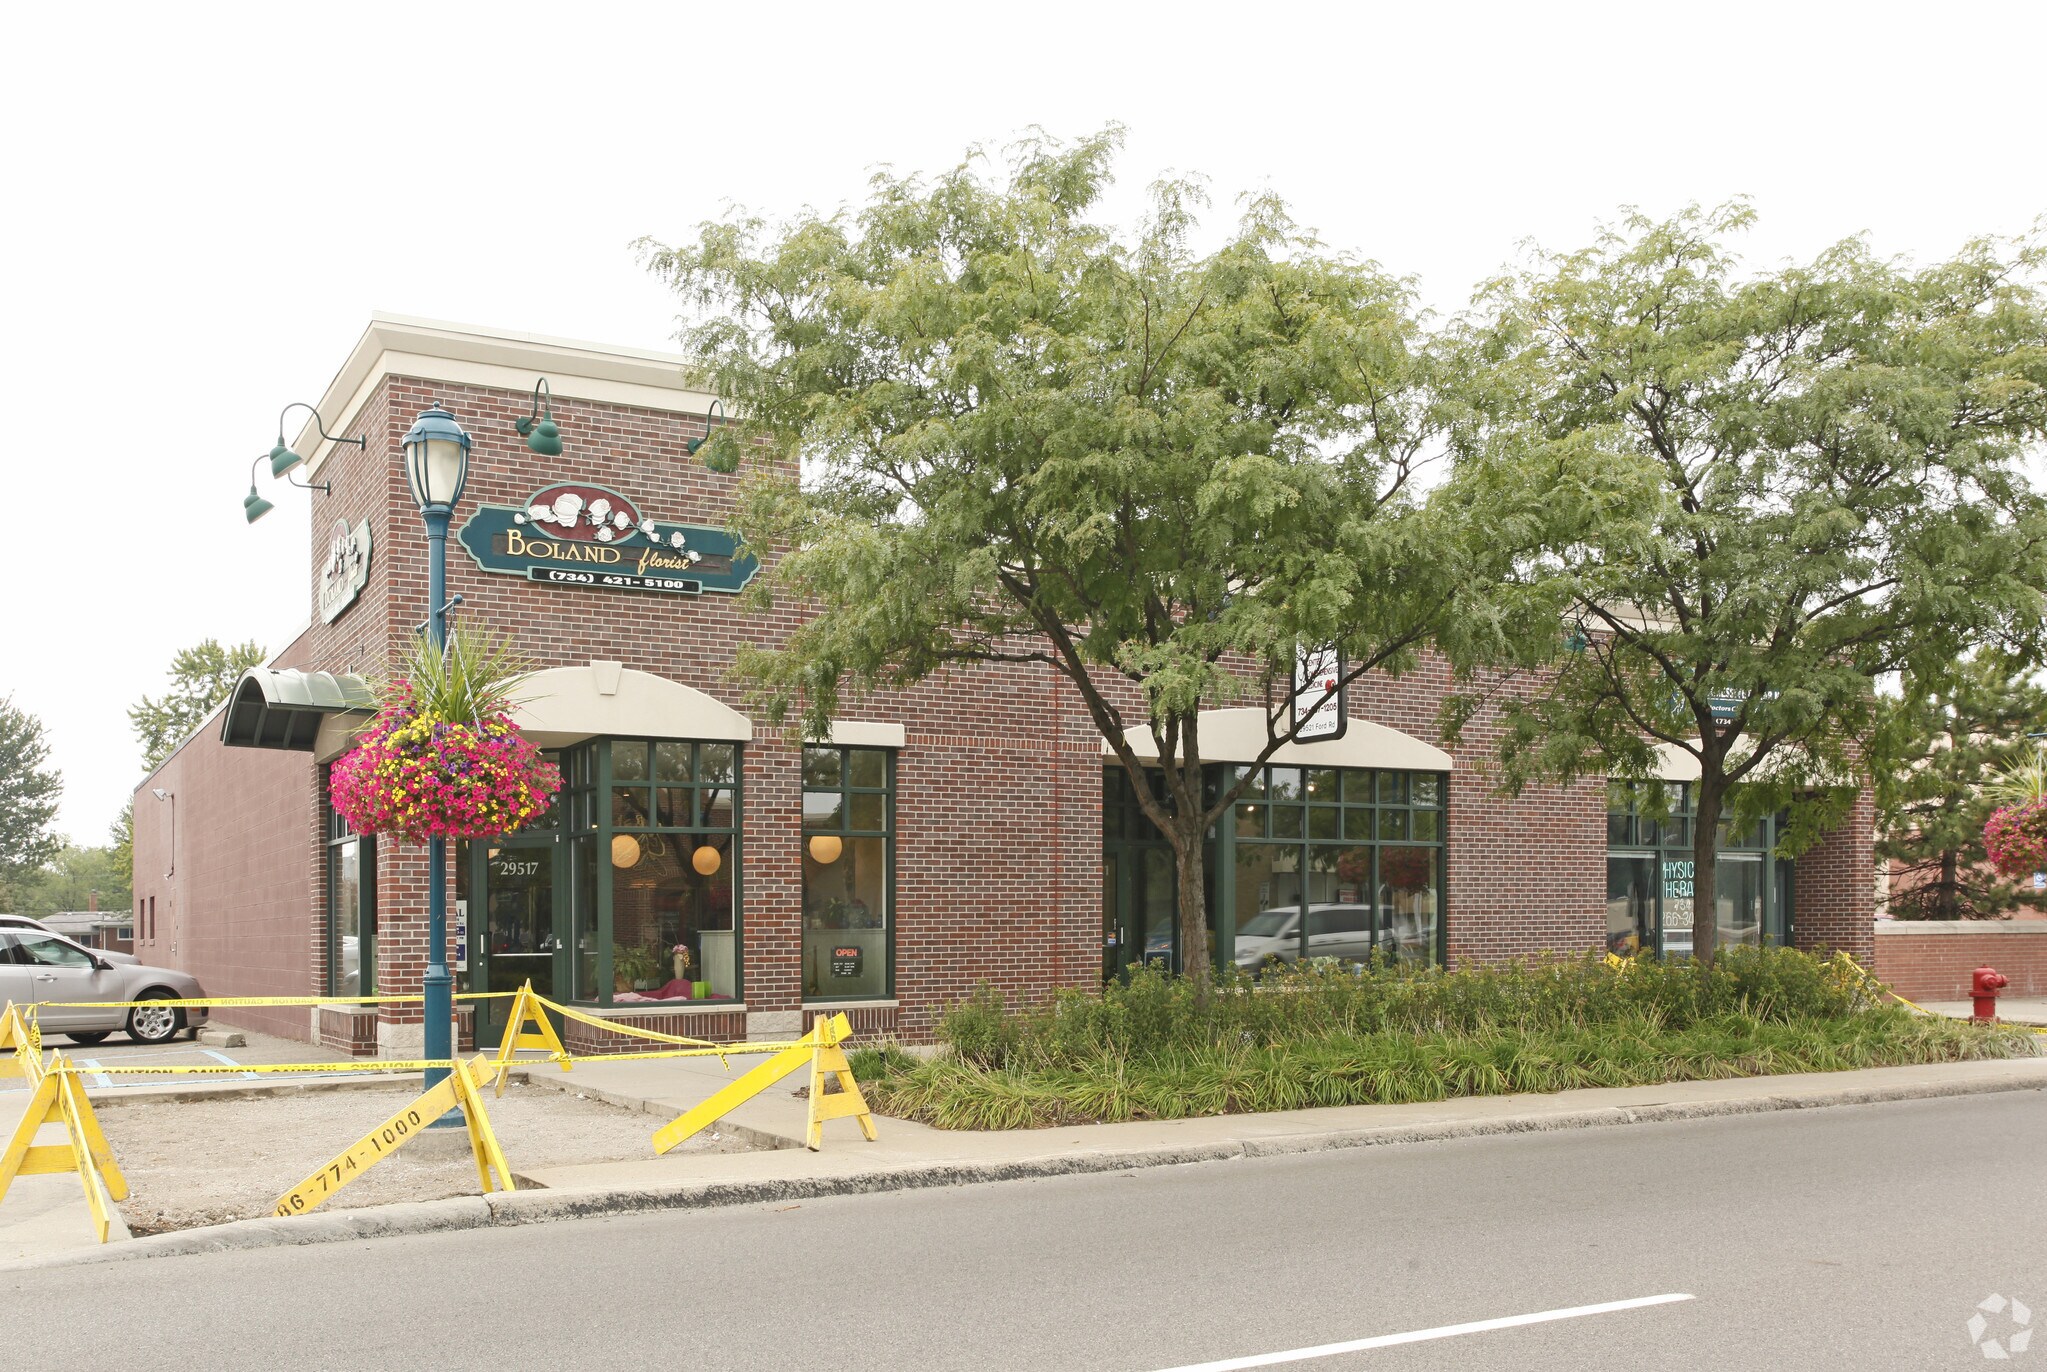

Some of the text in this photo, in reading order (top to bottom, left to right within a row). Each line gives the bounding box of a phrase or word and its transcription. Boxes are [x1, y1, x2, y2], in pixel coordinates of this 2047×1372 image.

[637, 547, 690, 576] florist
[549, 570, 595, 584] (734)
[1315, 722, 1327, 730] Ford
[1328, 720, 1336, 728] Rd
[500, 861, 539, 876] 29517
[1663, 861, 1694, 879] HYSIC
[1663, 881, 1694, 898] HERA
[835, 948, 858, 957] OPEN
